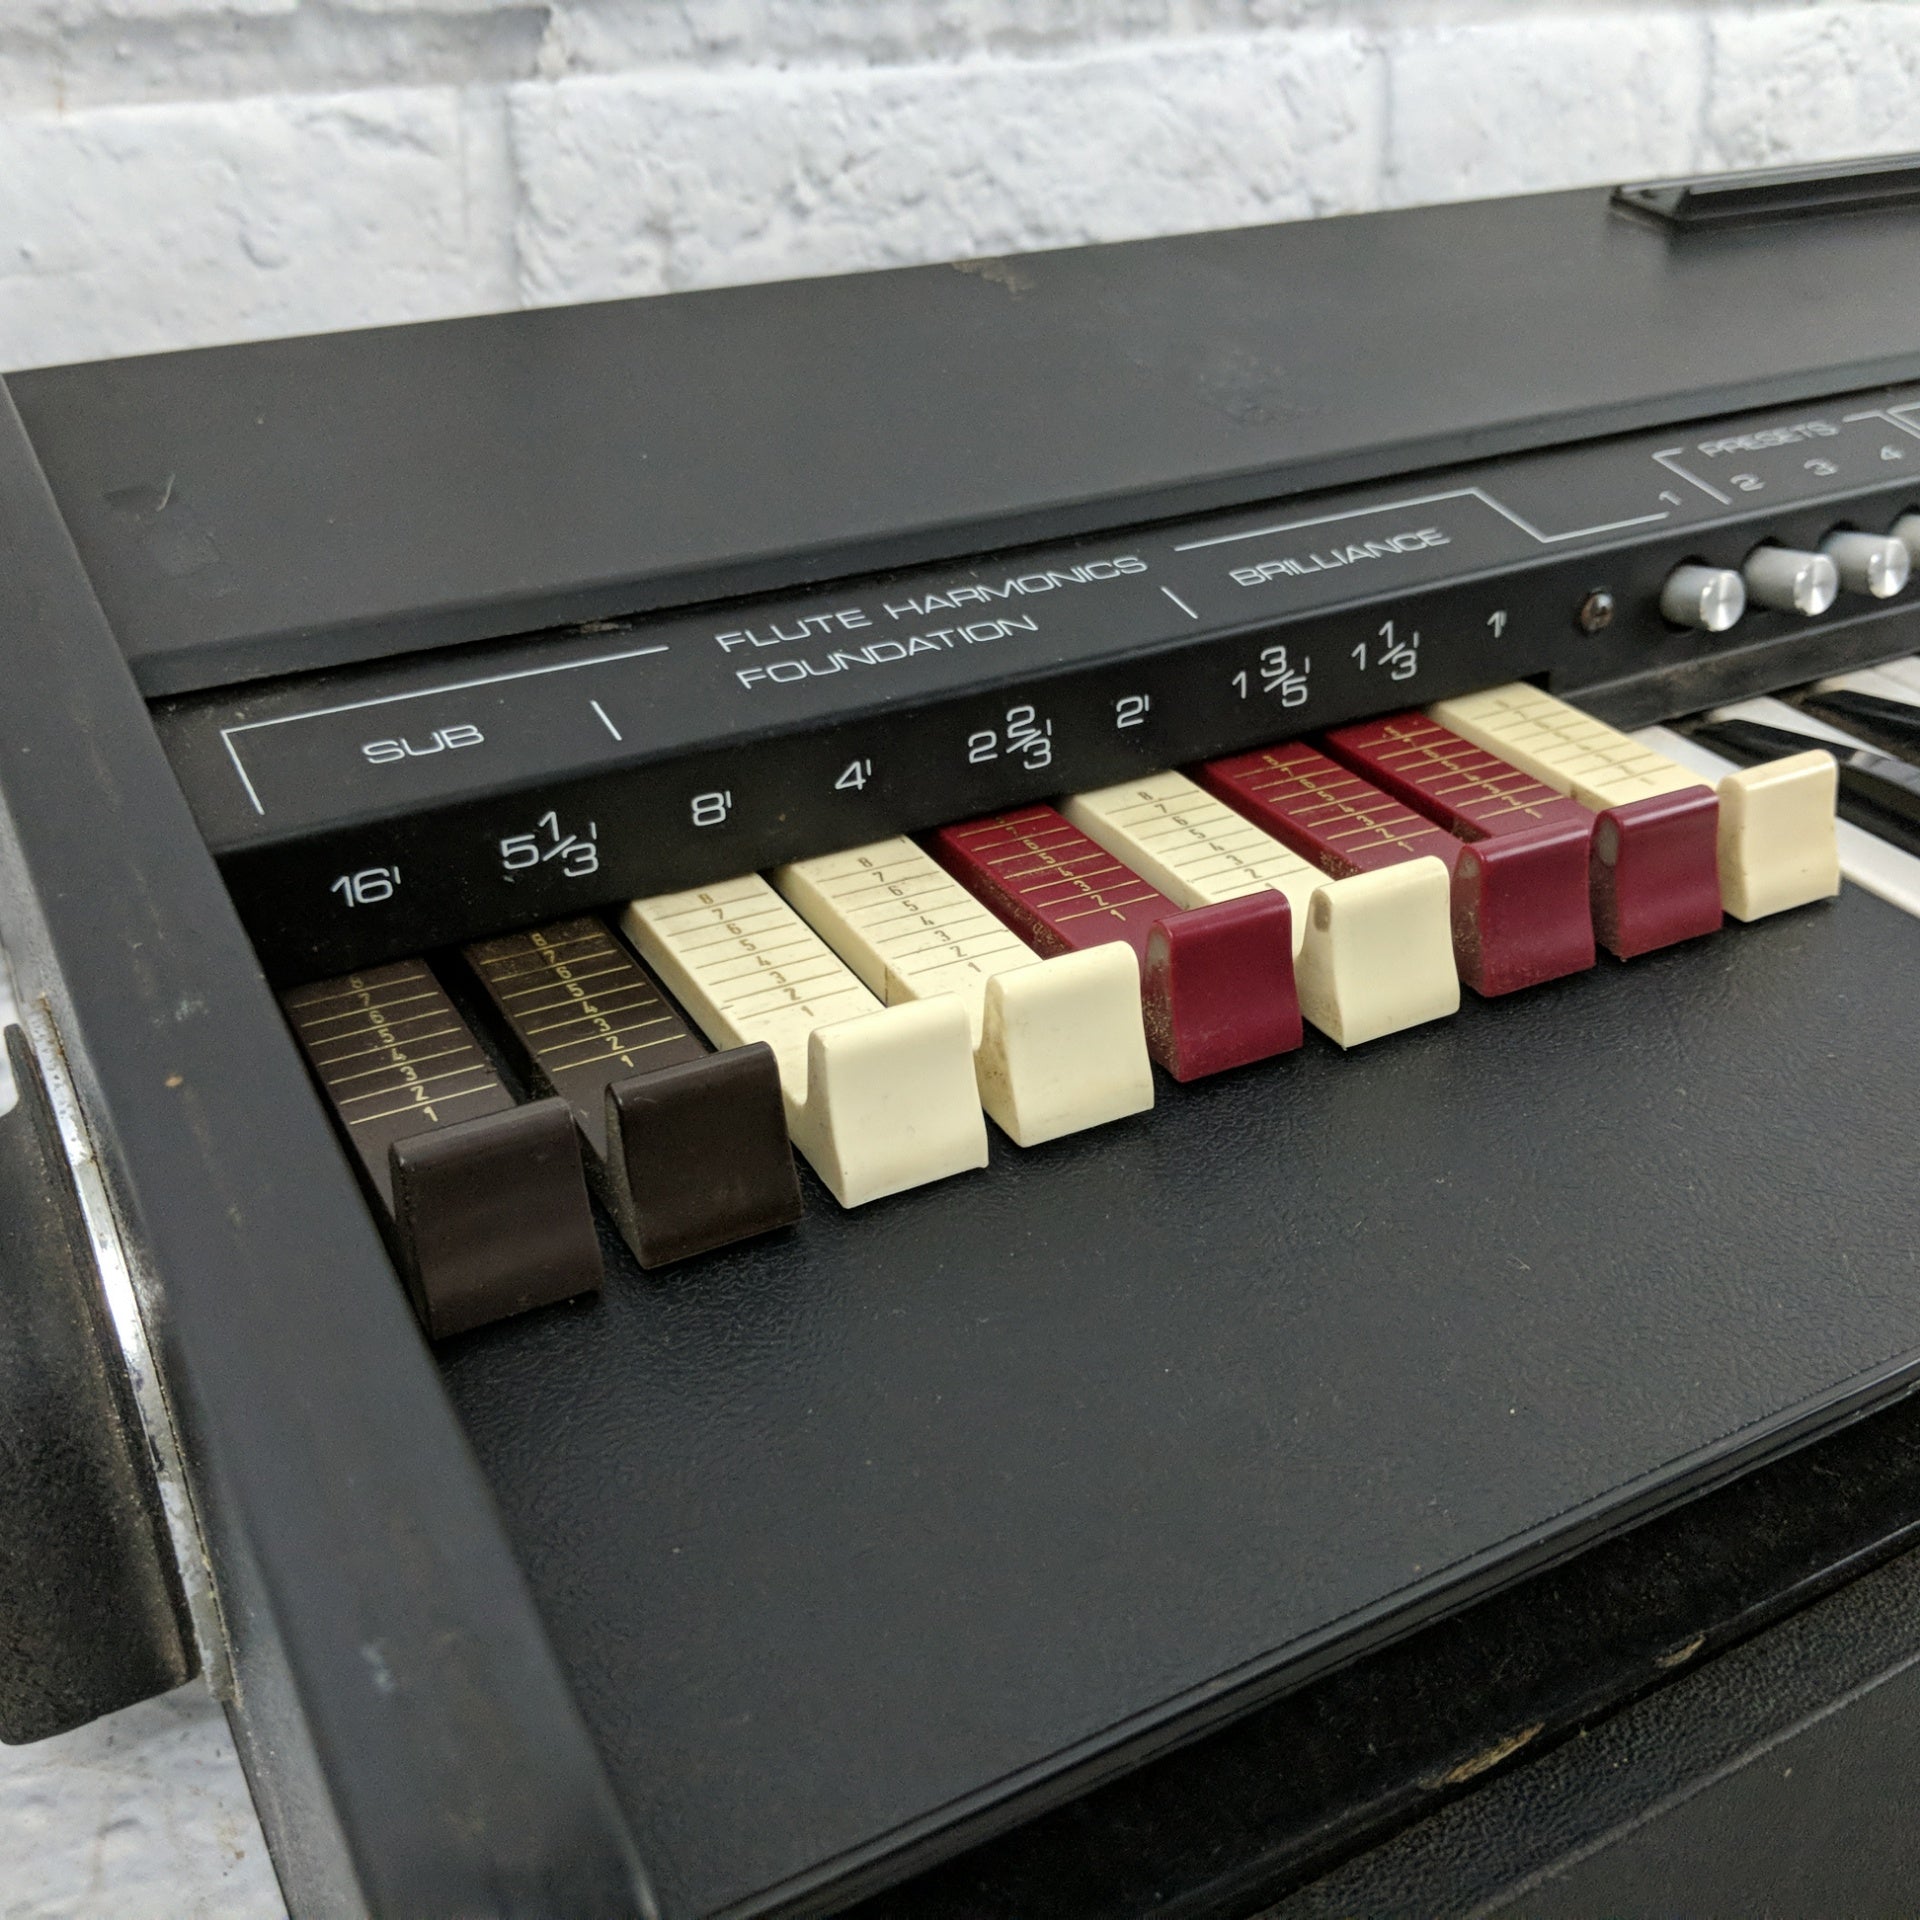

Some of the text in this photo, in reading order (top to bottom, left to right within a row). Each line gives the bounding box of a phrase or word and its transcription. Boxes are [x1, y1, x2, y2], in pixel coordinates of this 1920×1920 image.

[1697, 420, 1840, 458] PRESETS
[1658, 445, 1905, 506] 1 2 3 4
[1229, 527, 1450, 588] BRILLIANCE
[715, 556, 1149, 653] FLUTE HARMONICS
[736, 614, 1039, 690] FOUNDATION
[361, 724, 485, 765] SUB
[1300, 779, 1316, 788] 6
[1137, 791, 1153, 800] 8
[1317, 791, 1335, 801] 5
[1154, 803, 1167, 813] 7
[1172, 816, 1188, 825] 6
[1356, 815, 1374, 826] 3
[1189, 829, 1205, 839] 5
[1375, 828, 1395, 839] 2
[1023, 838, 1038, 850] 6
[1397, 841, 1414, 852] 1
[857, 858, 873, 867] 8
[1038, 852, 1056, 864] 5
[1226, 855, 1244, 865] 3
[872, 871, 884, 882] 7
[1058, 866, 1074, 877] 4
[1244, 869, 1262, 879] 2
[888, 886, 904, 896] 6
[1074, 880, 1091, 892] 3
[699, 893, 714, 905] 8
[1091, 894, 1109, 907] 2
[902, 900, 919, 912] 5
[712, 908, 723, 920] 7
[1110, 909, 1126, 921] 1
[919, 916, 934, 925] 4
[726, 923, 742, 935] 6
[532, 933, 547, 946] 8
[934, 930, 951, 942] 3
[739, 939, 756, 951] 5
[544, 950, 556, 963] 7
[950, 945, 967, 958] 2
[756, 956, 771, 966] 4
[967, 962, 981, 972] 1
[556, 966, 572, 979] 6
[769, 971, 786, 984] 3
[566, 983, 584, 997] 5
[783, 988, 801, 1001] 2
[358, 993, 370, 1006] 7
[583, 1001, 598, 1014] 4
[801, 1006, 814, 1016] 1
[370, 1011, 384, 1023] 6
[594, 1018, 610, 1032] 3
[378, 1028, 394, 1043] 5
[606, 1036, 625, 1050] 2
[392, 1048, 406, 1061] 4
[621, 1055, 634, 1067] 1
[401, 1066, 417, 1081] 3
[410, 1086, 429, 1101] 2
[424, 1107, 438, 1122] 1
